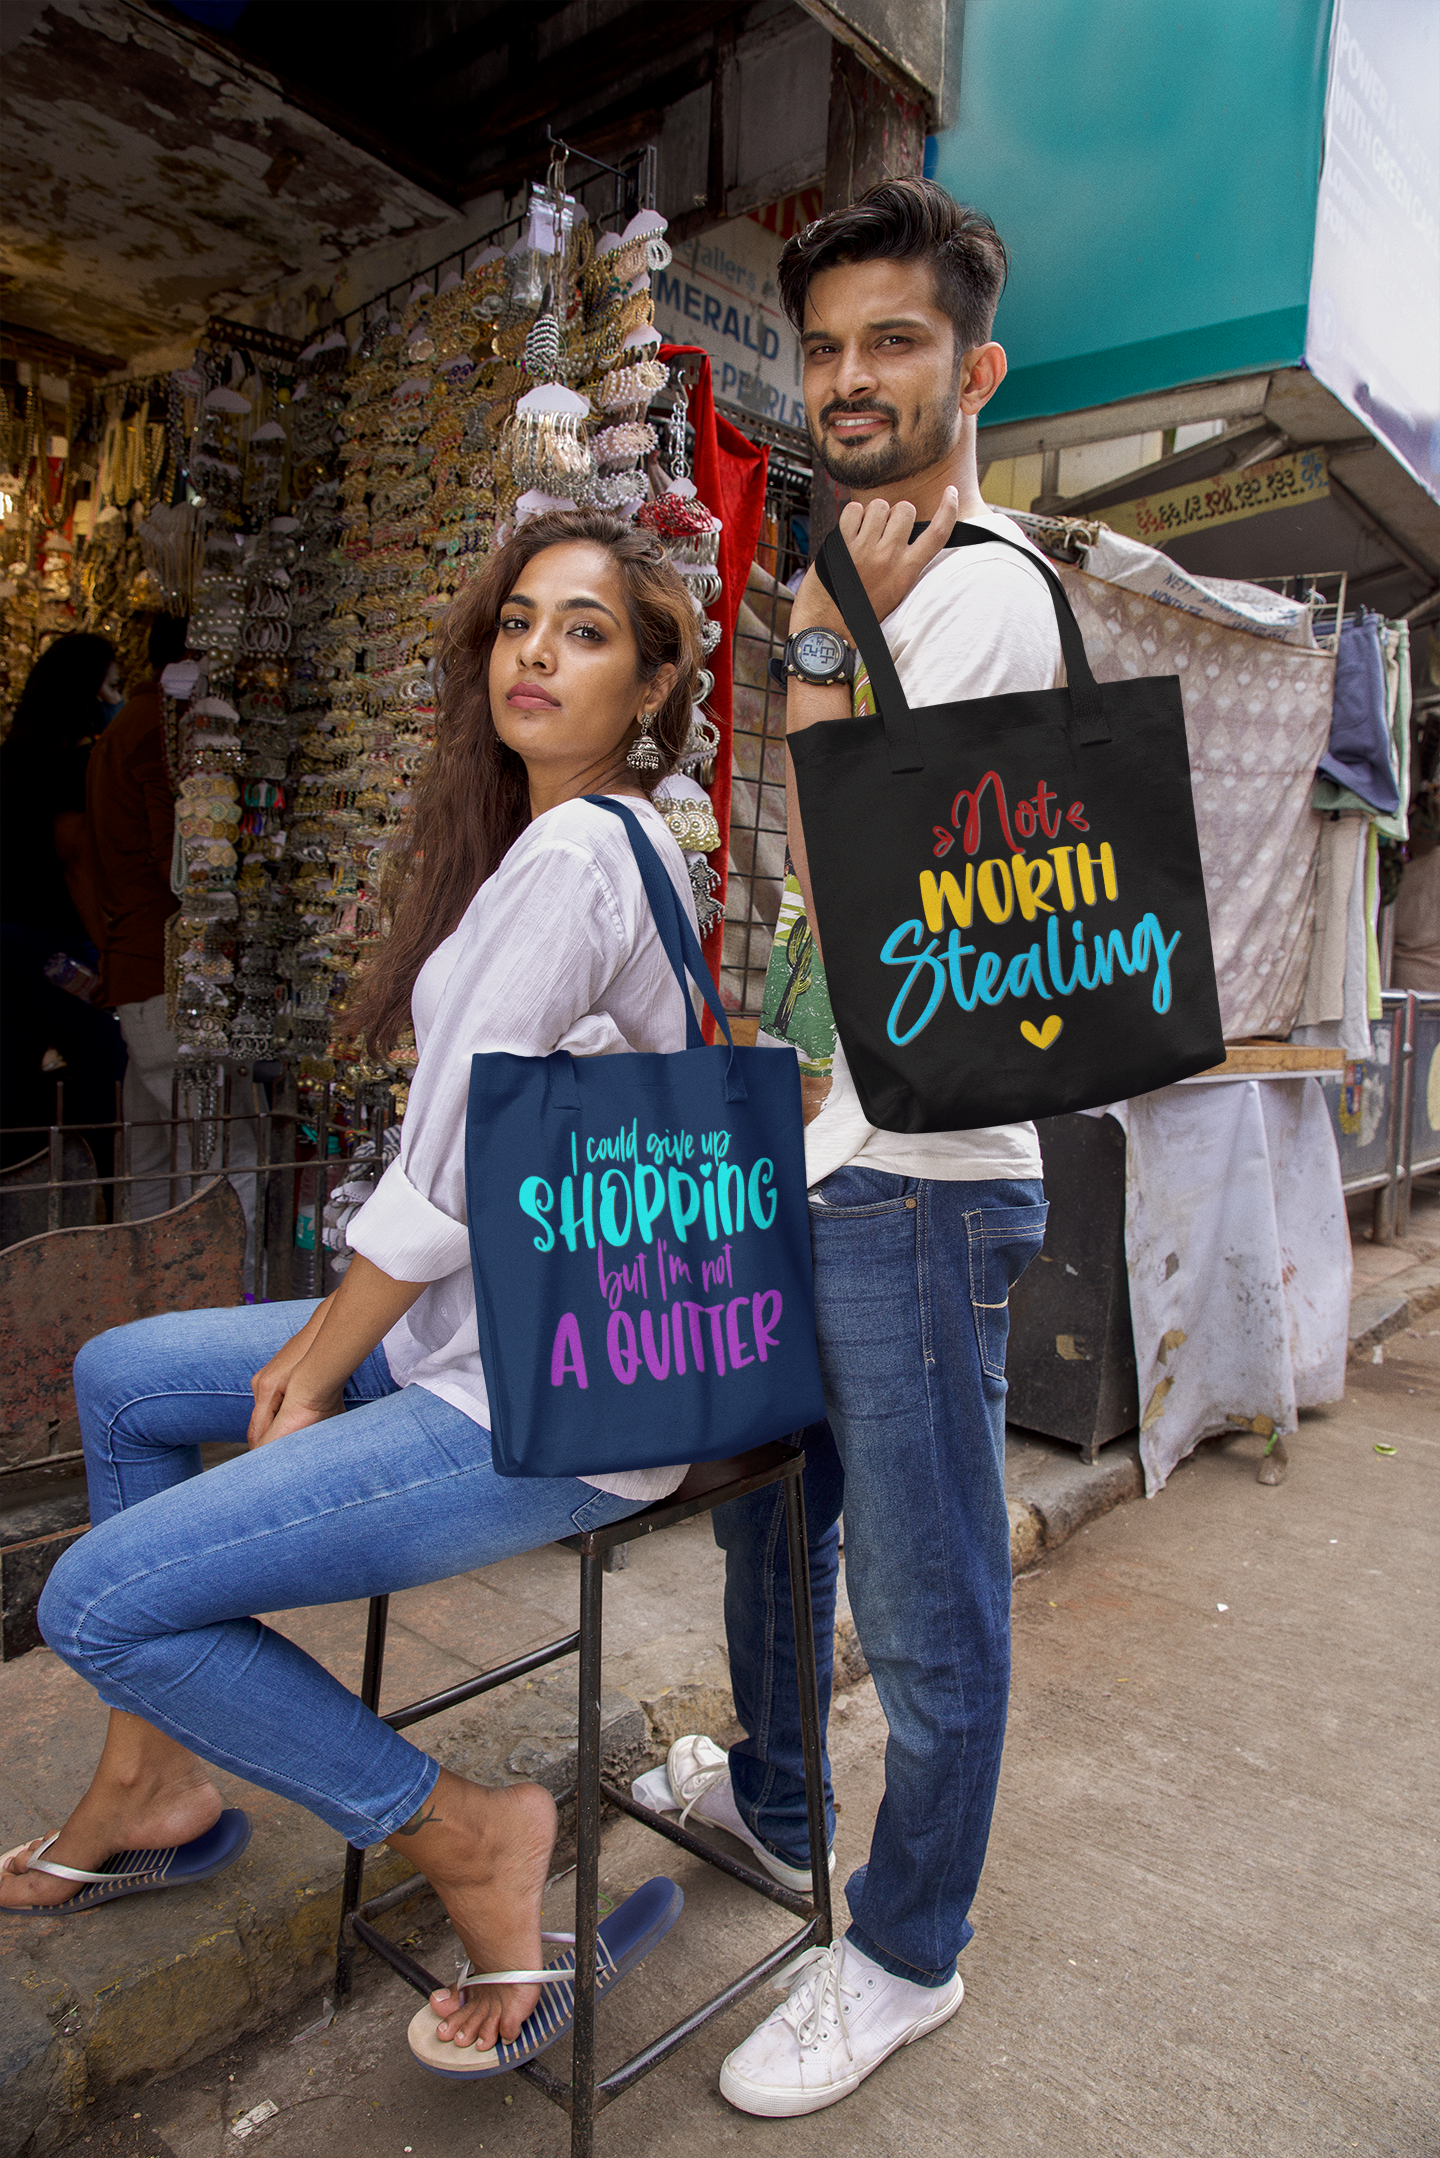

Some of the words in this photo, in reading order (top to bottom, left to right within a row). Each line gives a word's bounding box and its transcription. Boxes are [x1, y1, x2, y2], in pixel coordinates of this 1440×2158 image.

[951, 770, 1062, 855] Not
[919, 841, 1119, 933] WORTH
[879, 912, 1182, 1046] Stealing
[571, 1131, 578, 1176] I
[586, 1117, 639, 1166] could
[646, 1129, 695, 1166] give
[701, 1130, 732, 1166] up
[598, 1239, 648, 1310] but
[657, 1238, 693, 1301] I'm
[701, 1243, 733, 1293] not
[551, 1312, 589, 1390] A
[606, 1289, 783, 1386] QUITTER
